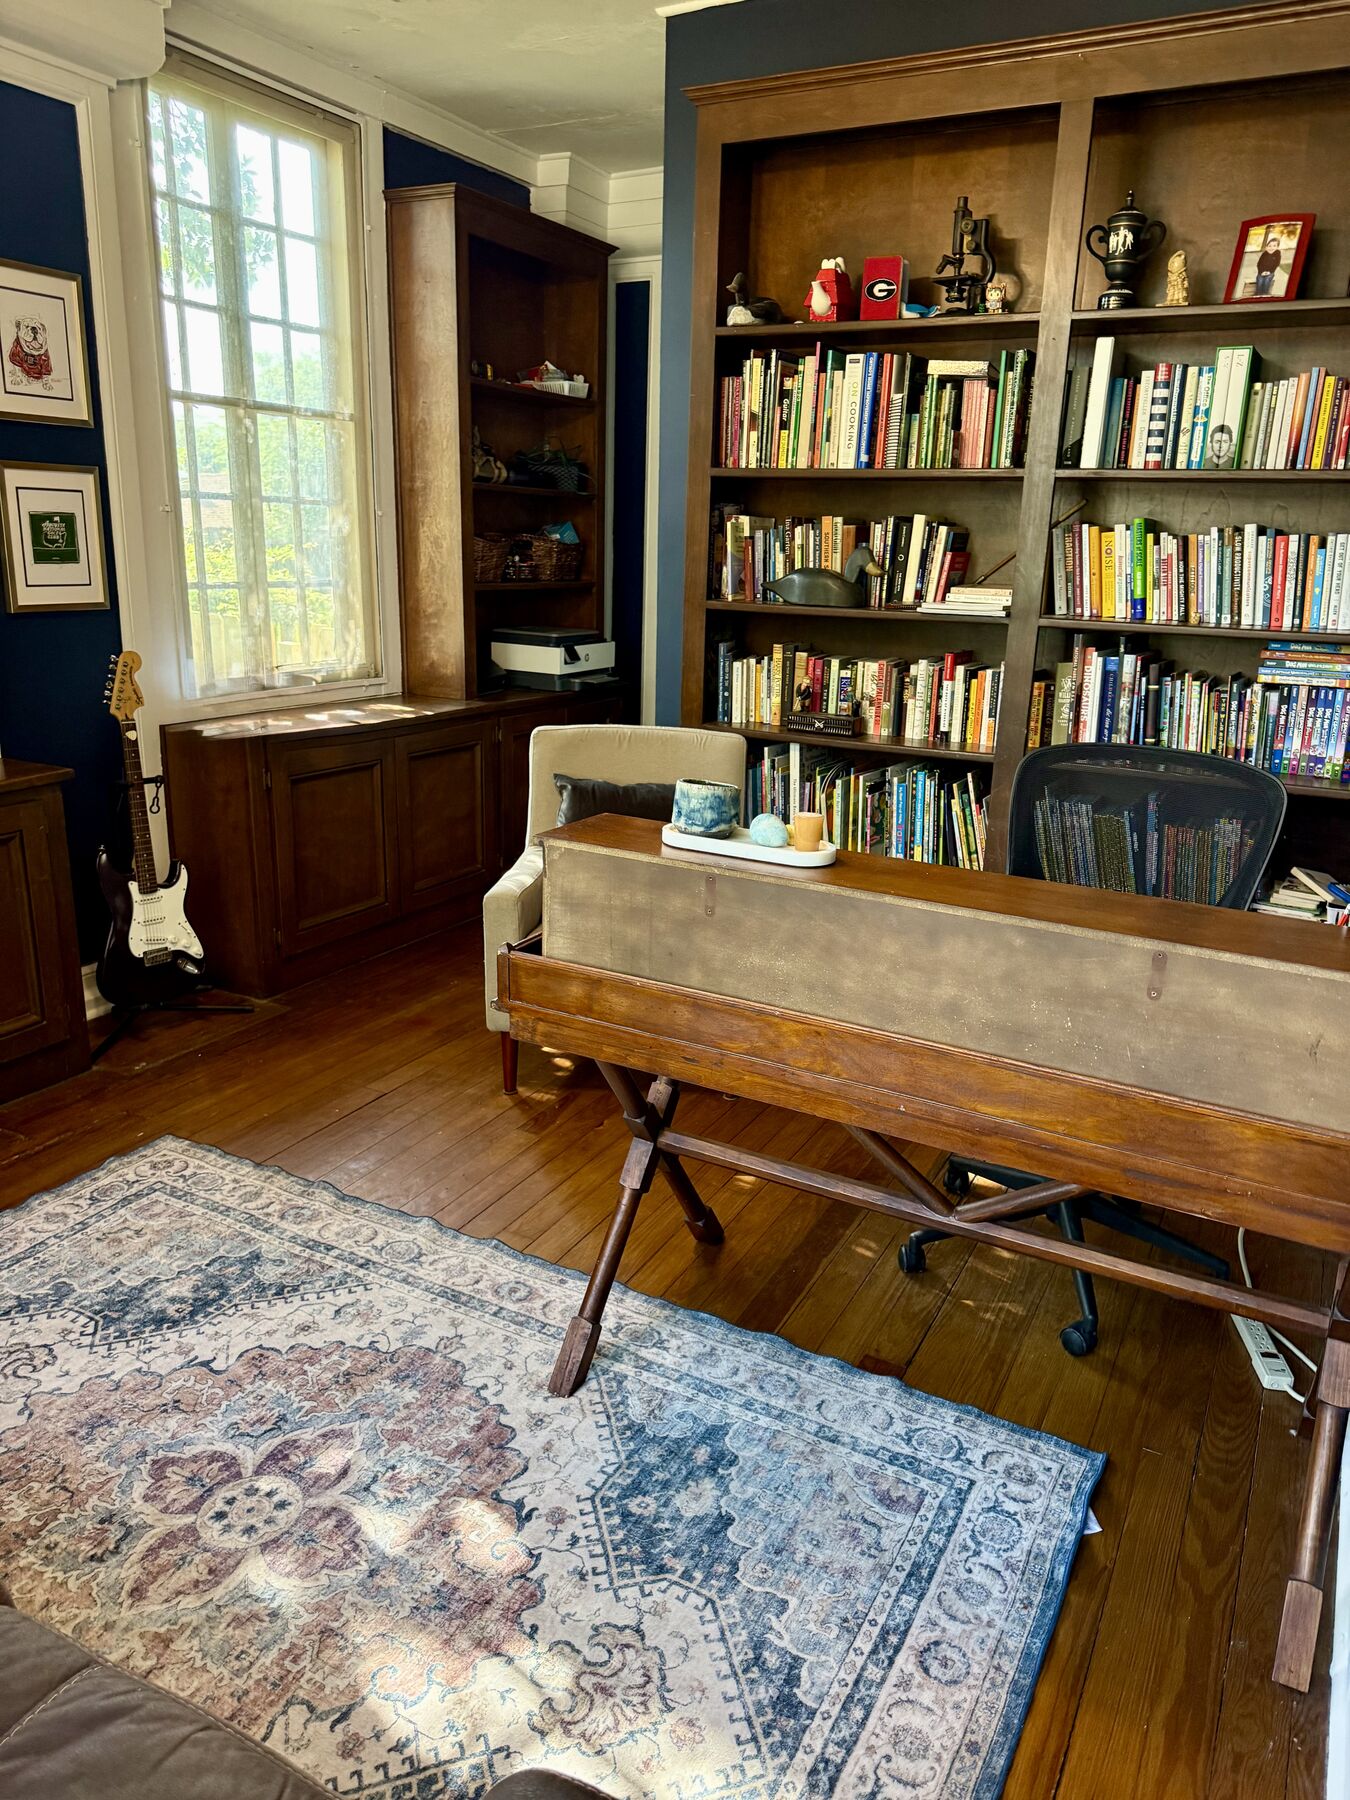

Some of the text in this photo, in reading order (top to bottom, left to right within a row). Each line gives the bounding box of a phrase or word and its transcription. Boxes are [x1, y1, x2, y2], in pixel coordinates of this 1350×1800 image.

[869, 281, 897, 299] G
[863, 391, 871, 422] IMPROVEMENT
[1202, 386, 1211, 407] Office
[847, 382, 858, 449] ON COOKING
[1065, 533, 1073, 571] TRACTION
[1104, 540, 1113, 571] NOISE
[1233, 553, 1242, 590] PRODUCTIVITY
[840, 679, 848, 700] KING
[1081, 665, 1093, 721] DINOSAURS
[1324, 709, 1332, 718] DOG
